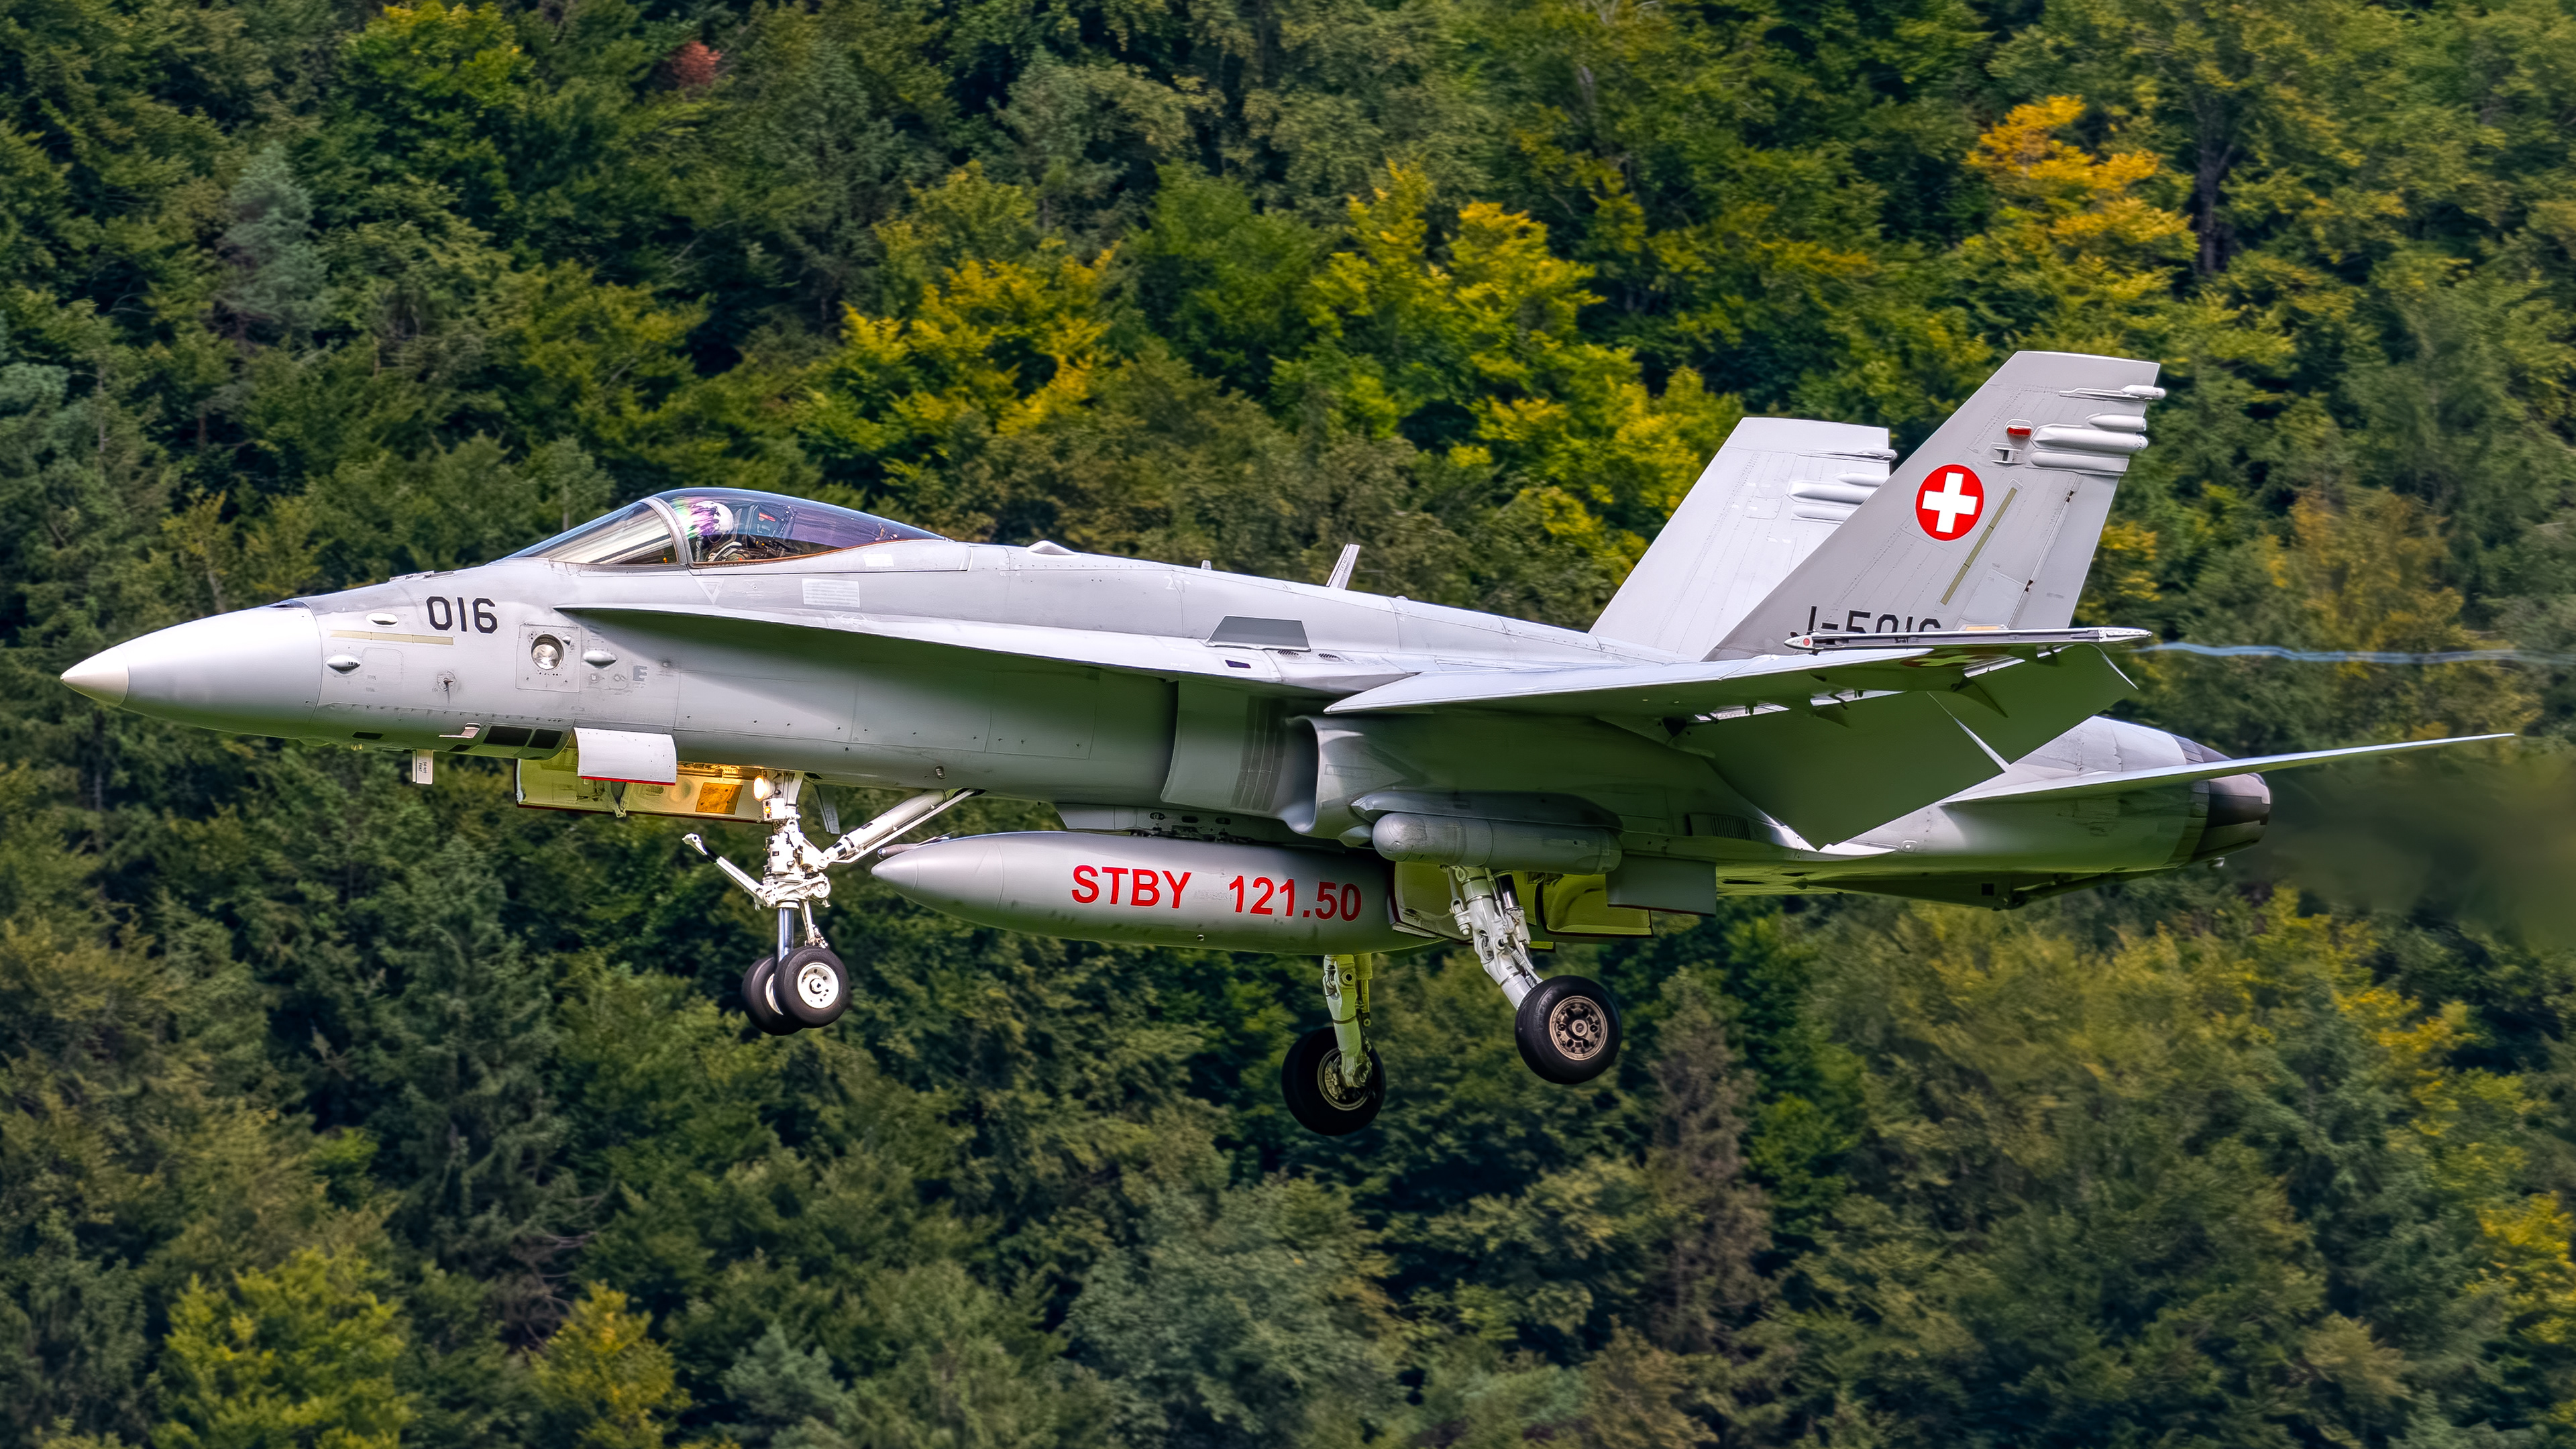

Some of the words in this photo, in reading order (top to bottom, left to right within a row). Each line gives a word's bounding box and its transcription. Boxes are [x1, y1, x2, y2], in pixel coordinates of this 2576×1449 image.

[426, 596, 498, 634] 016
[1071, 865, 1192, 909] STBY
[1228, 875, 1362, 921] 121.50
